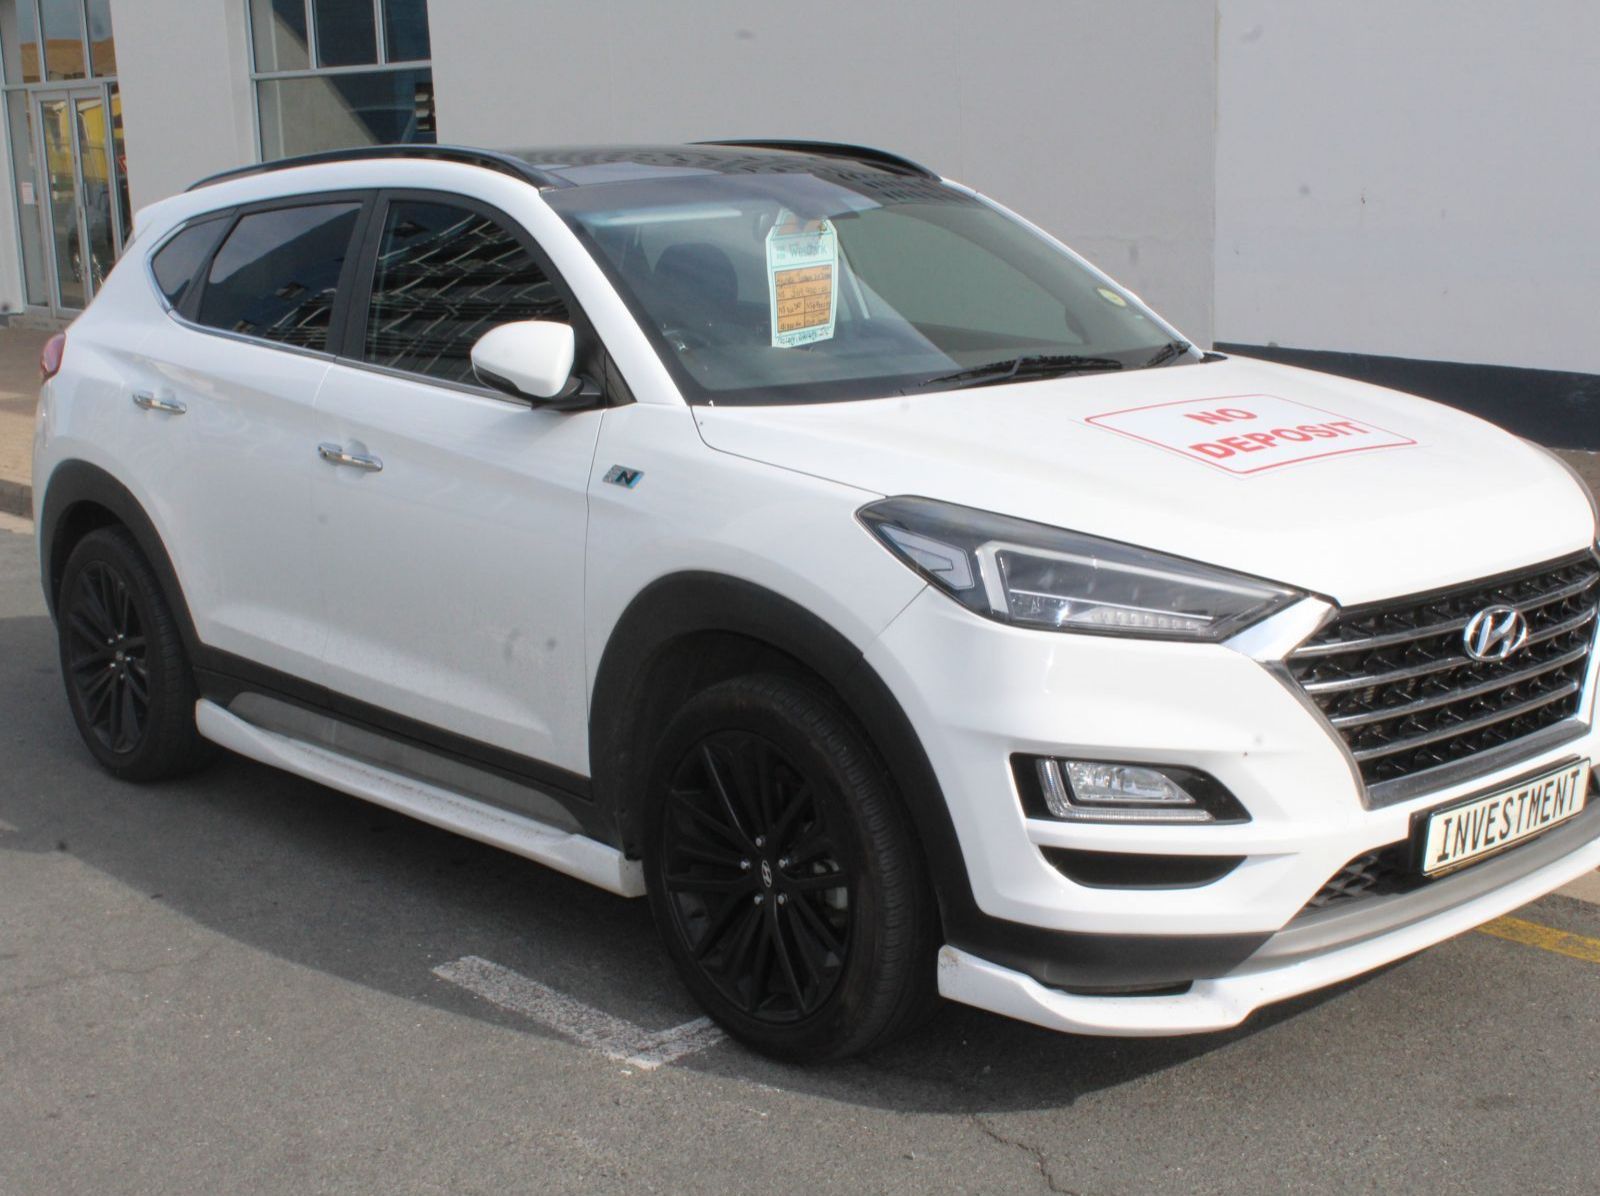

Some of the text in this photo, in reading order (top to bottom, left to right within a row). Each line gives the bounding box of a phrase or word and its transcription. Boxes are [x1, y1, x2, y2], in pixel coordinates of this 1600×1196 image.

[1184, 408, 1258, 425] NO
[1188, 421, 1369, 459] DEPOSIT
[1437, 769, 1579, 862] INVESTMENT
